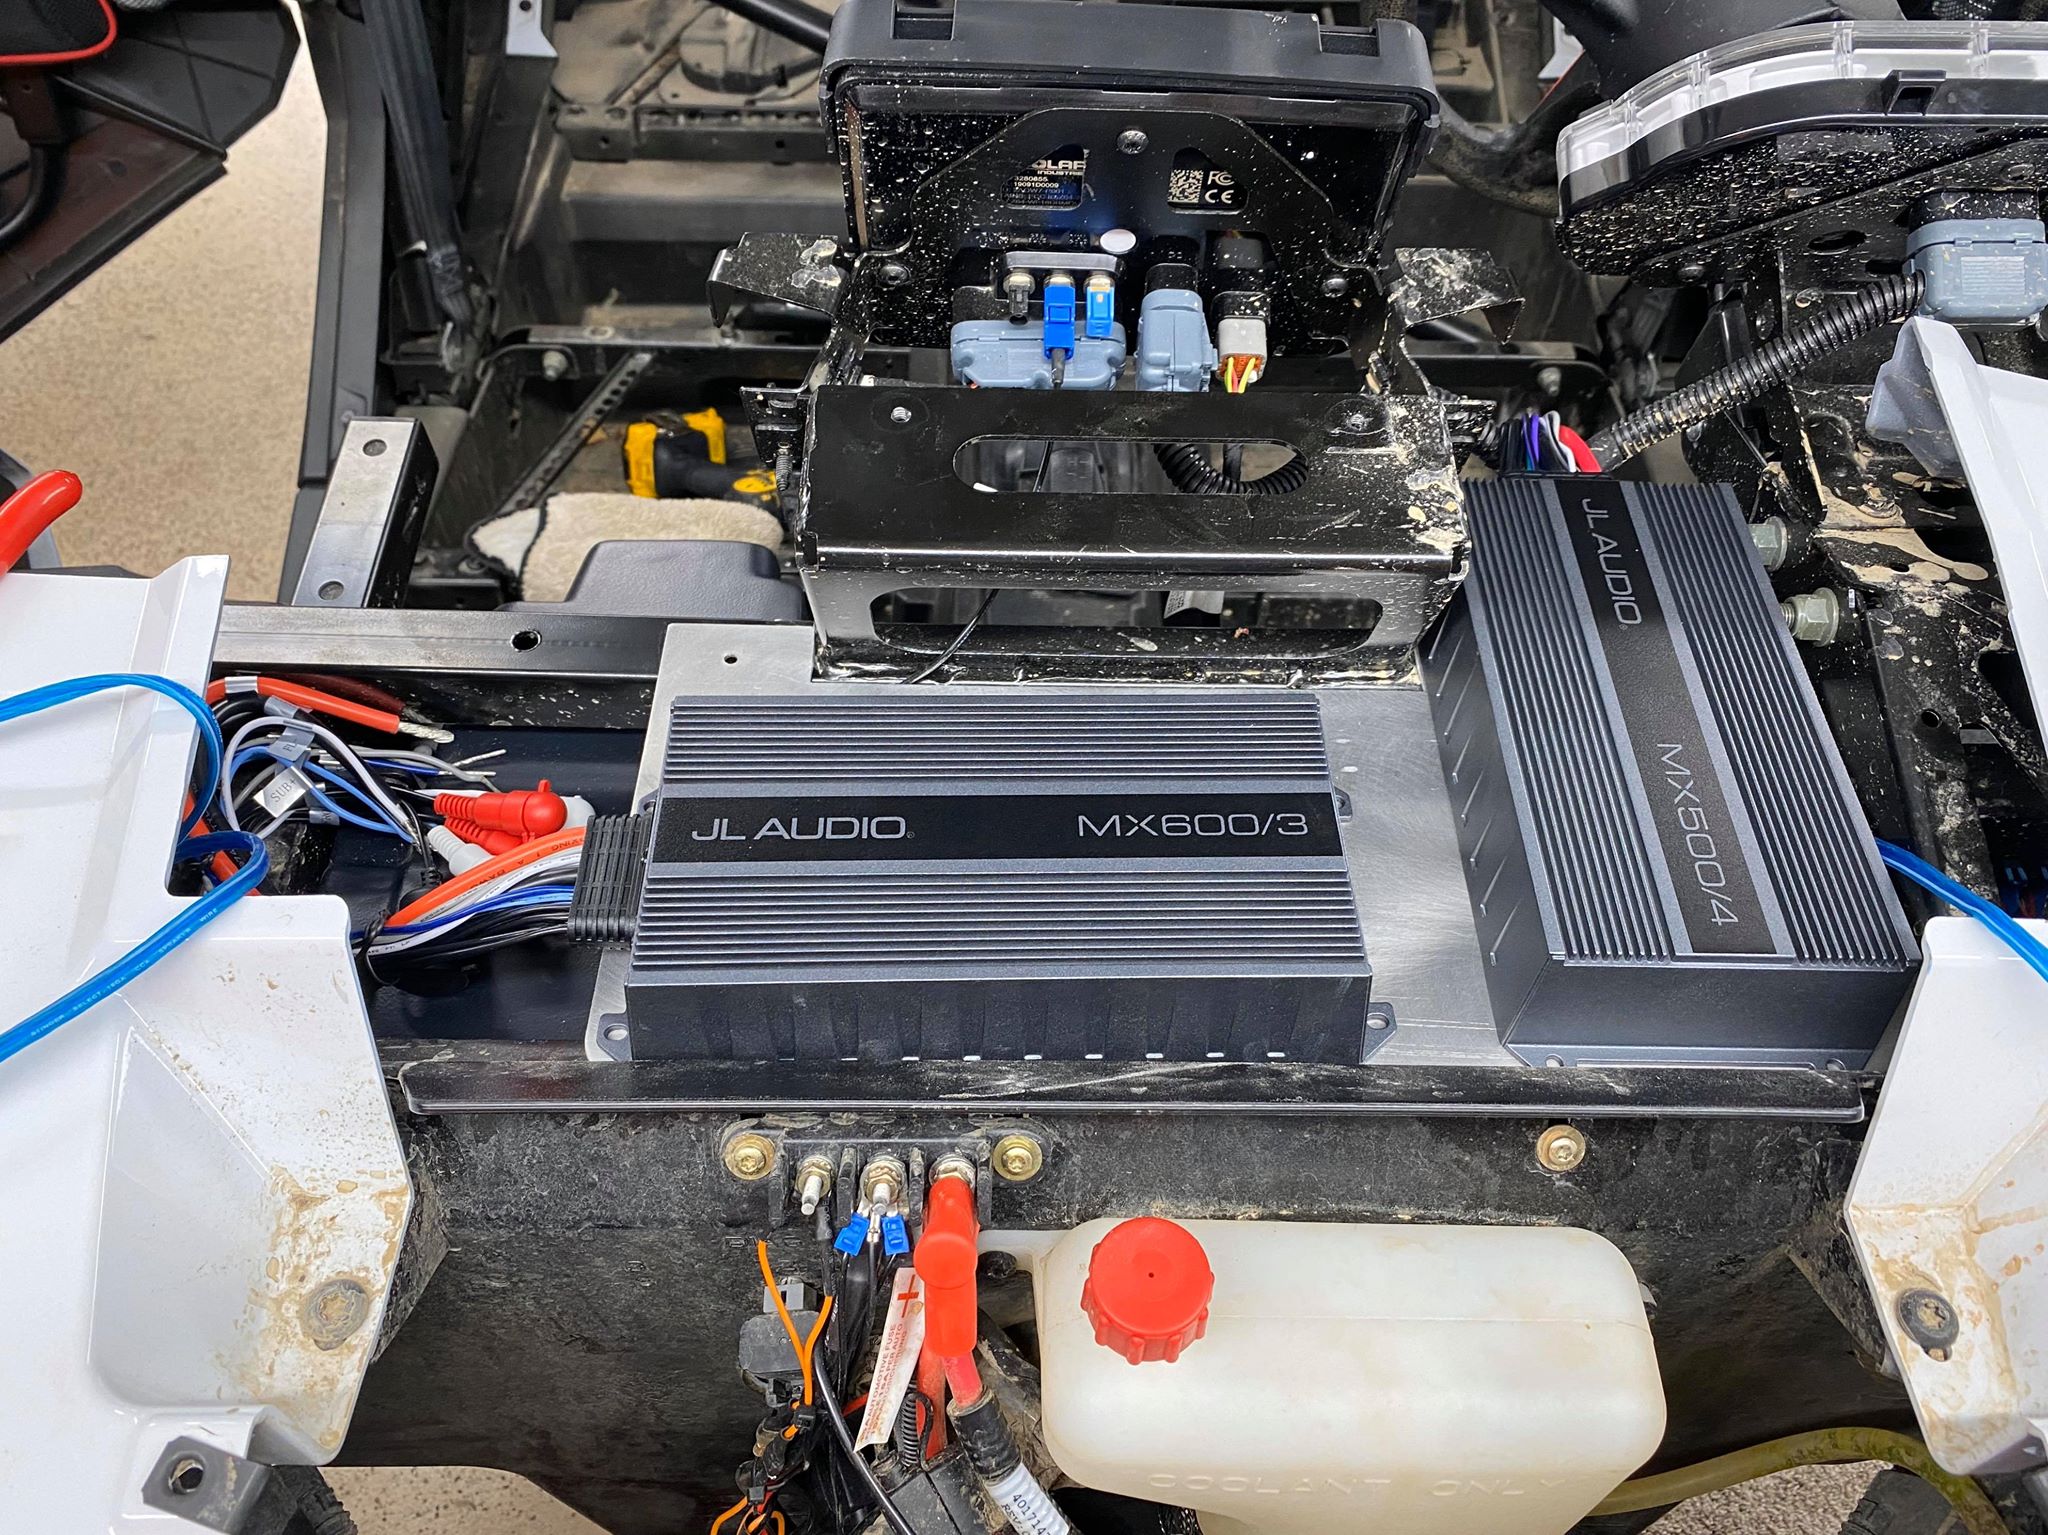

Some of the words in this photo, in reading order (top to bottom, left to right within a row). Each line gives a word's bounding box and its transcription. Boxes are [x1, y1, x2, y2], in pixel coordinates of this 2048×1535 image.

[1582, 497, 1604, 535] JL
[1592, 533, 1642, 626] AUDIO
[270, 778, 297, 803] SUB+
[692, 817, 746, 842] JL
[753, 815, 907, 841] AUDIO
[1077, 813, 1309, 838] MX600/3
[1657, 742, 1739, 927] MX500/4
[885, 1324, 897, 1351] FUSE
[1146, 1473, 1391, 1496] COOLANT
[1430, 1477, 1568, 1496] ONLY
